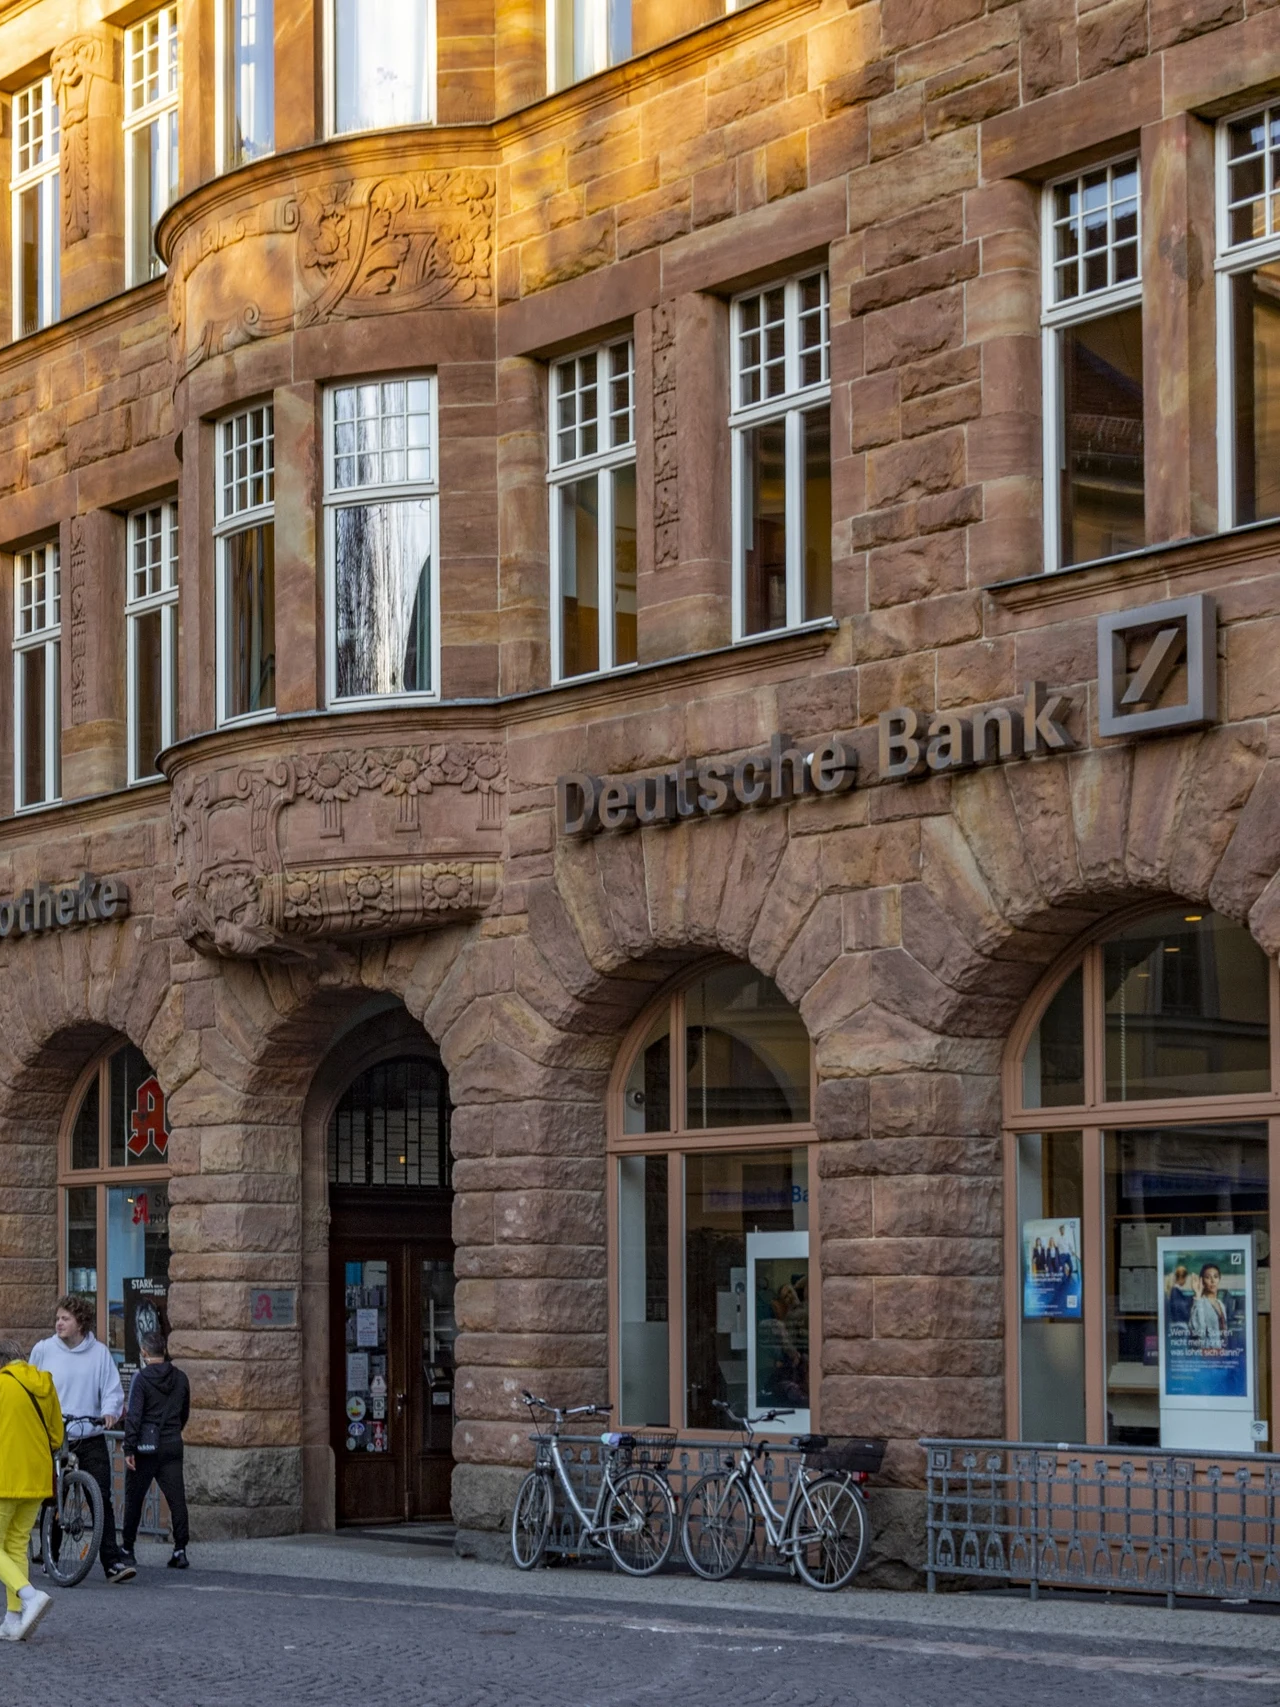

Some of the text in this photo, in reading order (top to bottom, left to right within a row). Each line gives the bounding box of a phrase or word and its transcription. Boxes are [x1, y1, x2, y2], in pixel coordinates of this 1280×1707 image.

[557, 680, 1078, 836] Deutsche Bank
[131, 1279, 153, 1290] STARK
